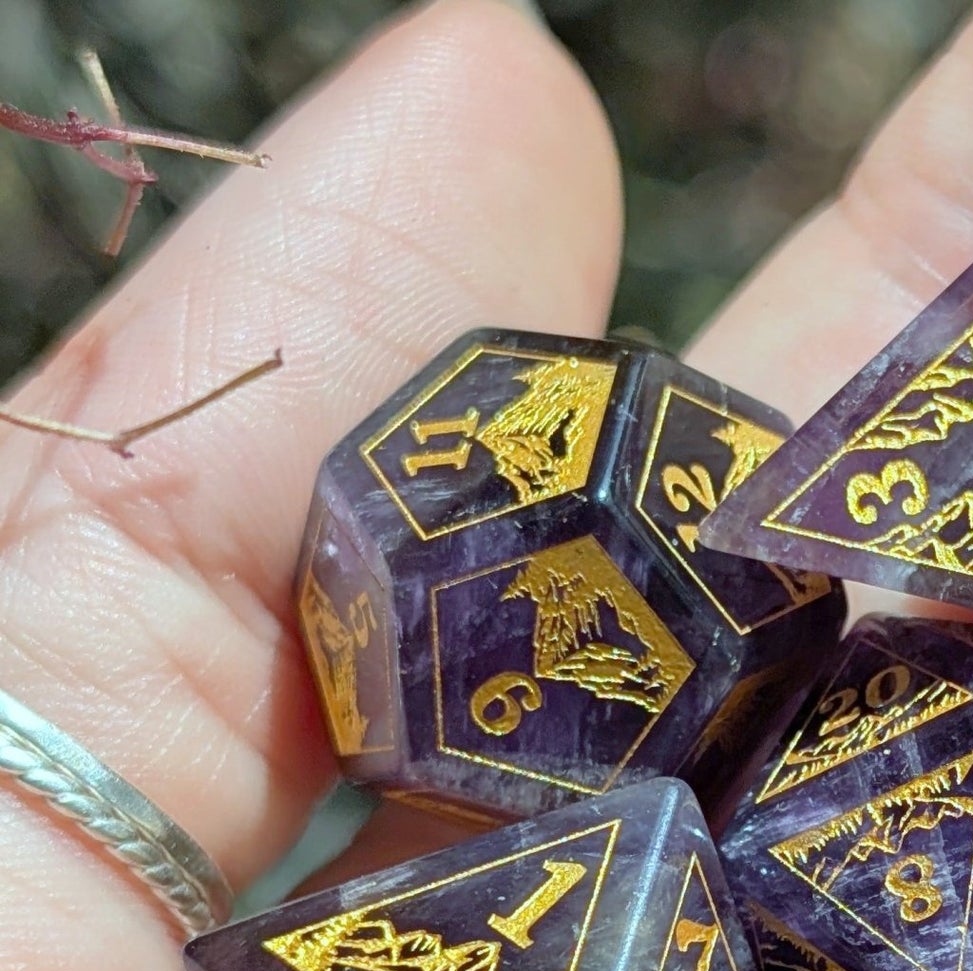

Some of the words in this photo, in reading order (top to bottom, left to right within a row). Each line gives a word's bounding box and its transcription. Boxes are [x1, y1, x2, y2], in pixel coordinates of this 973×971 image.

[404, 407, 480, 477] 11
[847, 459, 928, 524] 3
[819, 665, 911, 736] 20
[487, 860, 587, 950] 1
[885, 855, 942, 922] 8
